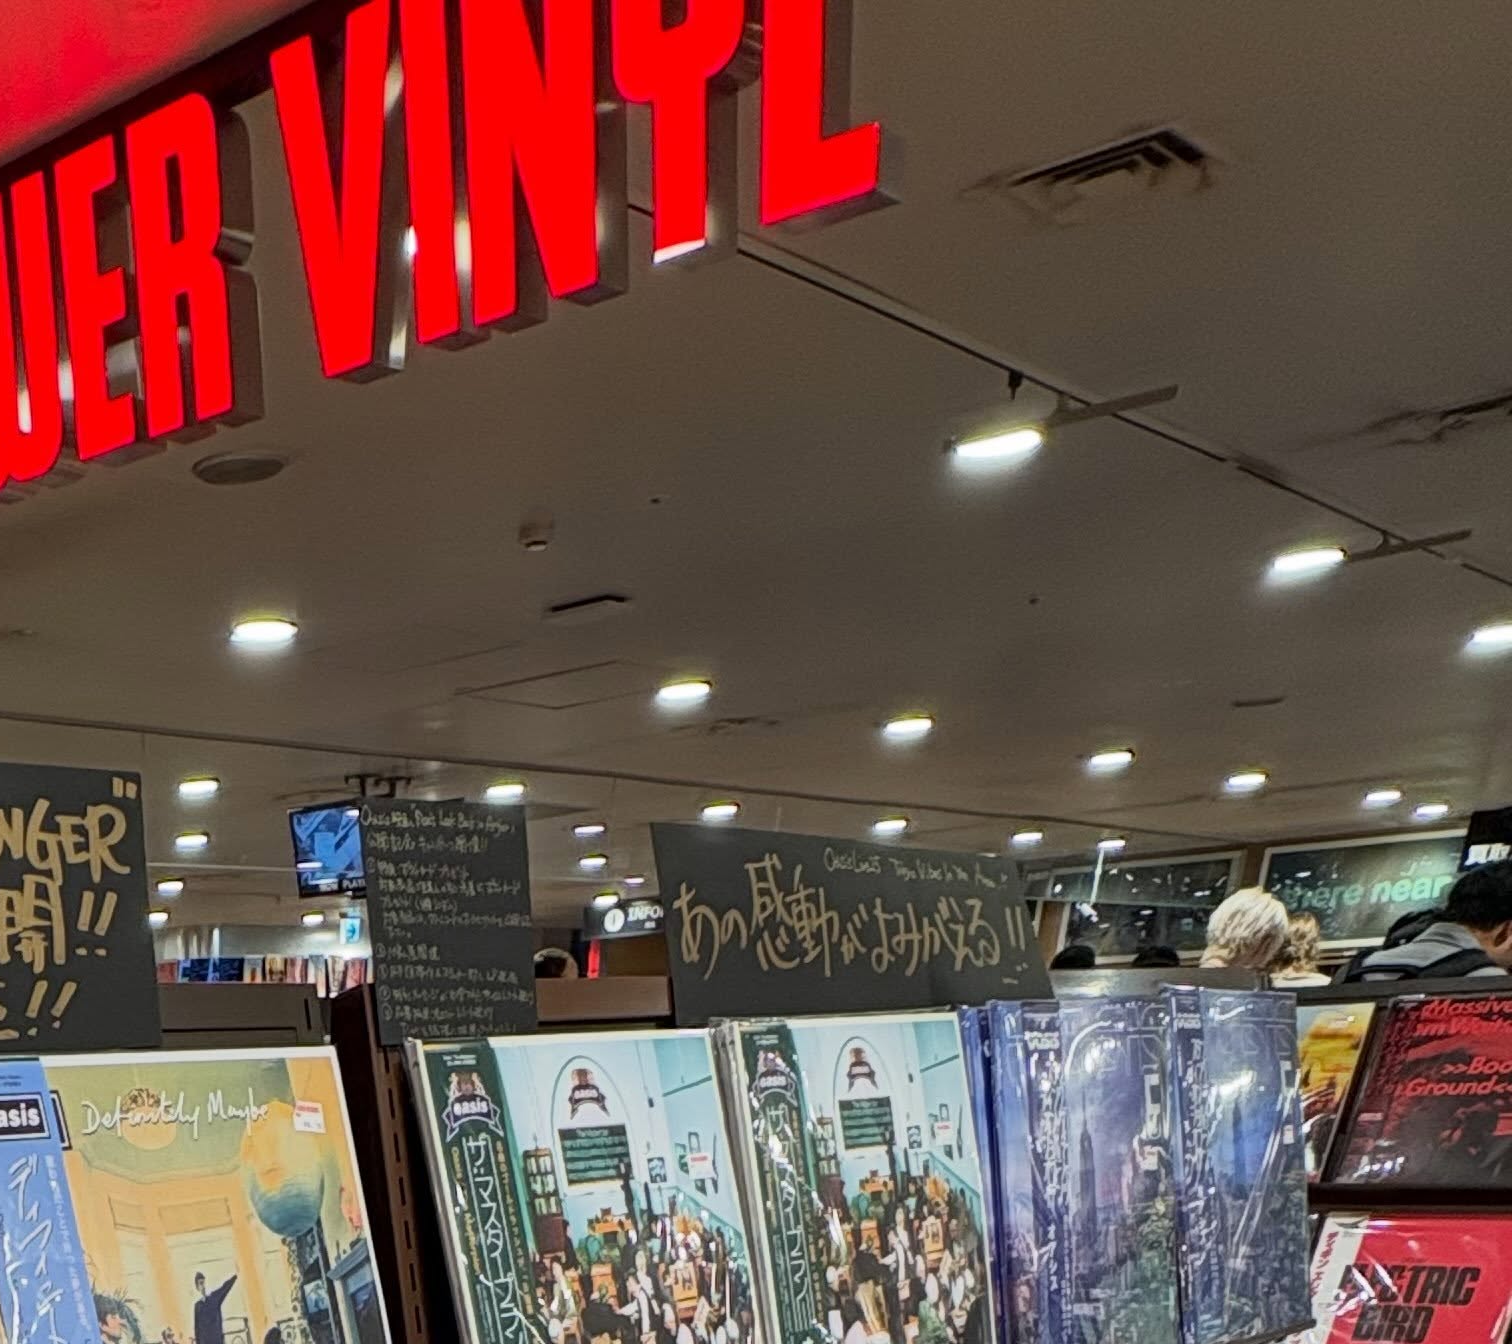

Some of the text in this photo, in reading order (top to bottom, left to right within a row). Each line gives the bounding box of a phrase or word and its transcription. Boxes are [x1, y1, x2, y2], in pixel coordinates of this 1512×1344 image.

[270, 0, 882, 378] VINYL
[81, 1088, 270, 1140] Definitely Maybe
[453, 1097, 489, 1116] oasis
